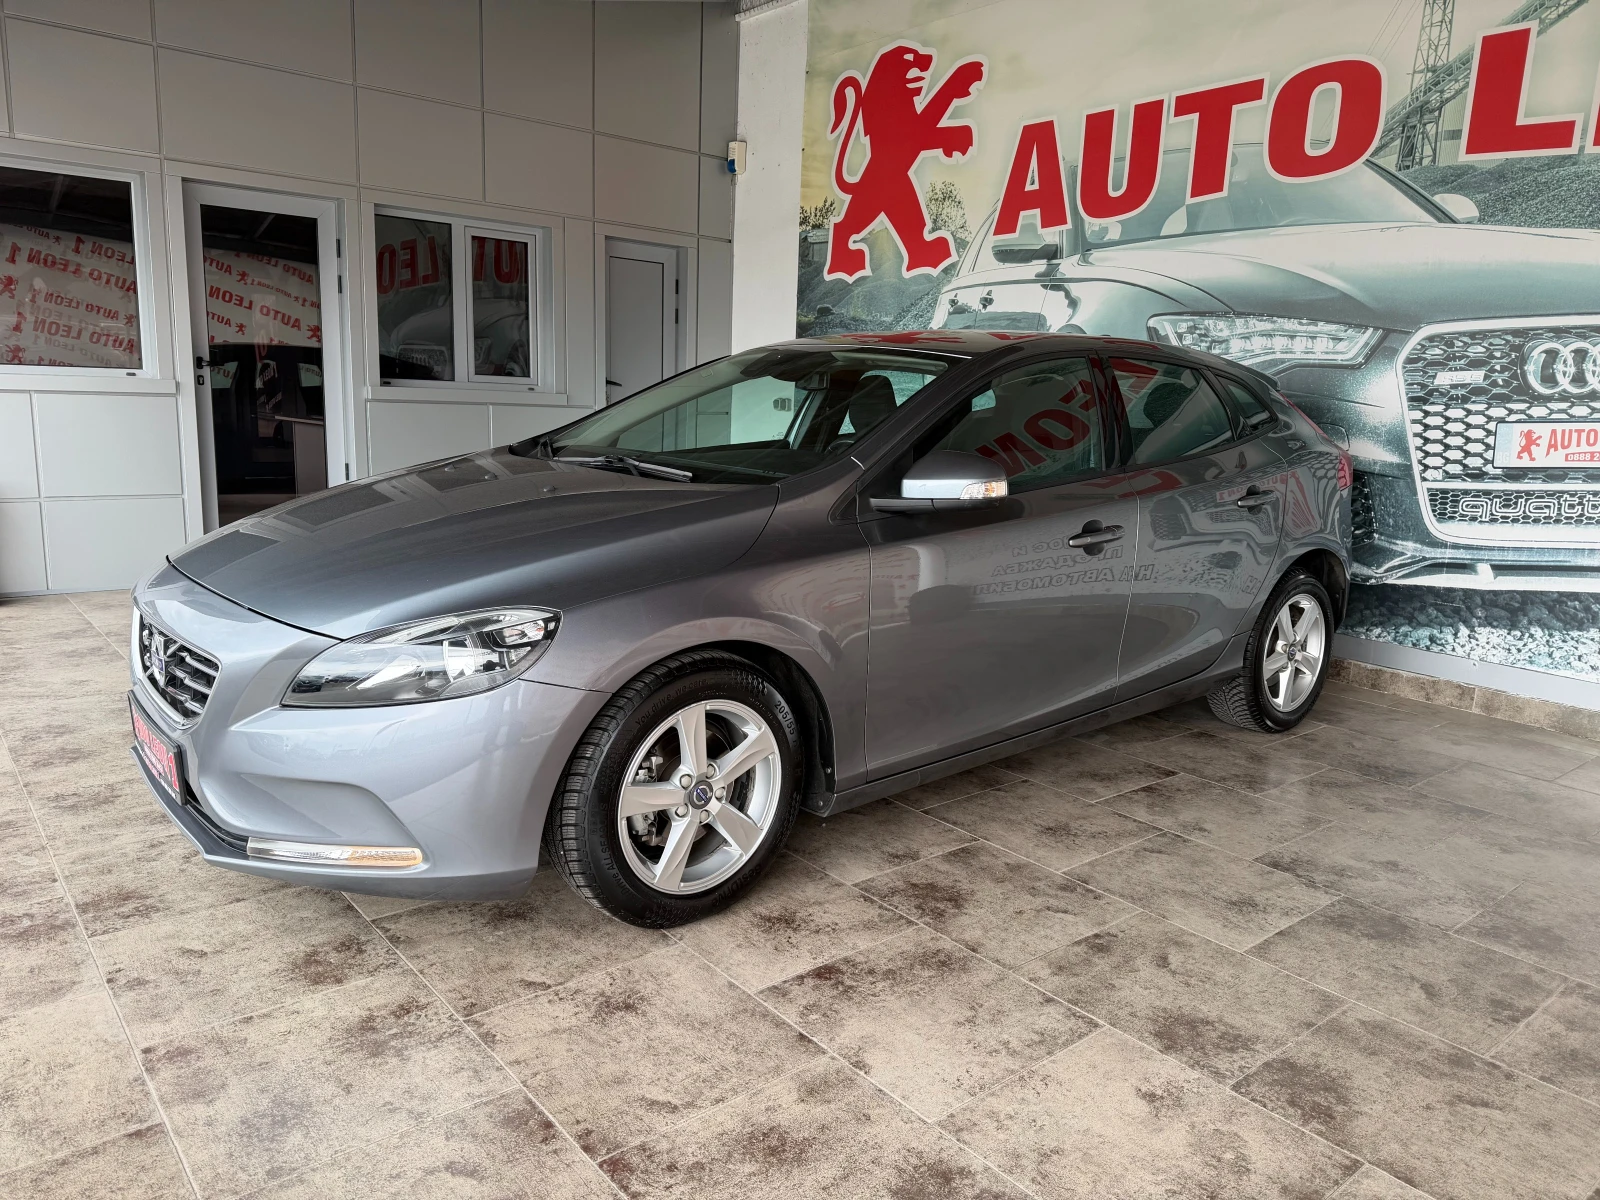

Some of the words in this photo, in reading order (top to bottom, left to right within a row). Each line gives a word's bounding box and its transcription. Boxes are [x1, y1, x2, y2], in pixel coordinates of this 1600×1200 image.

[992, 59, 1383, 237] AUTO
[1465, 27, 1600, 156] L
[1545, 428, 1599, 459] AUTO
[1568, 453, 1591, 461] 0888
[774, 701, 797, 735] 205/55
